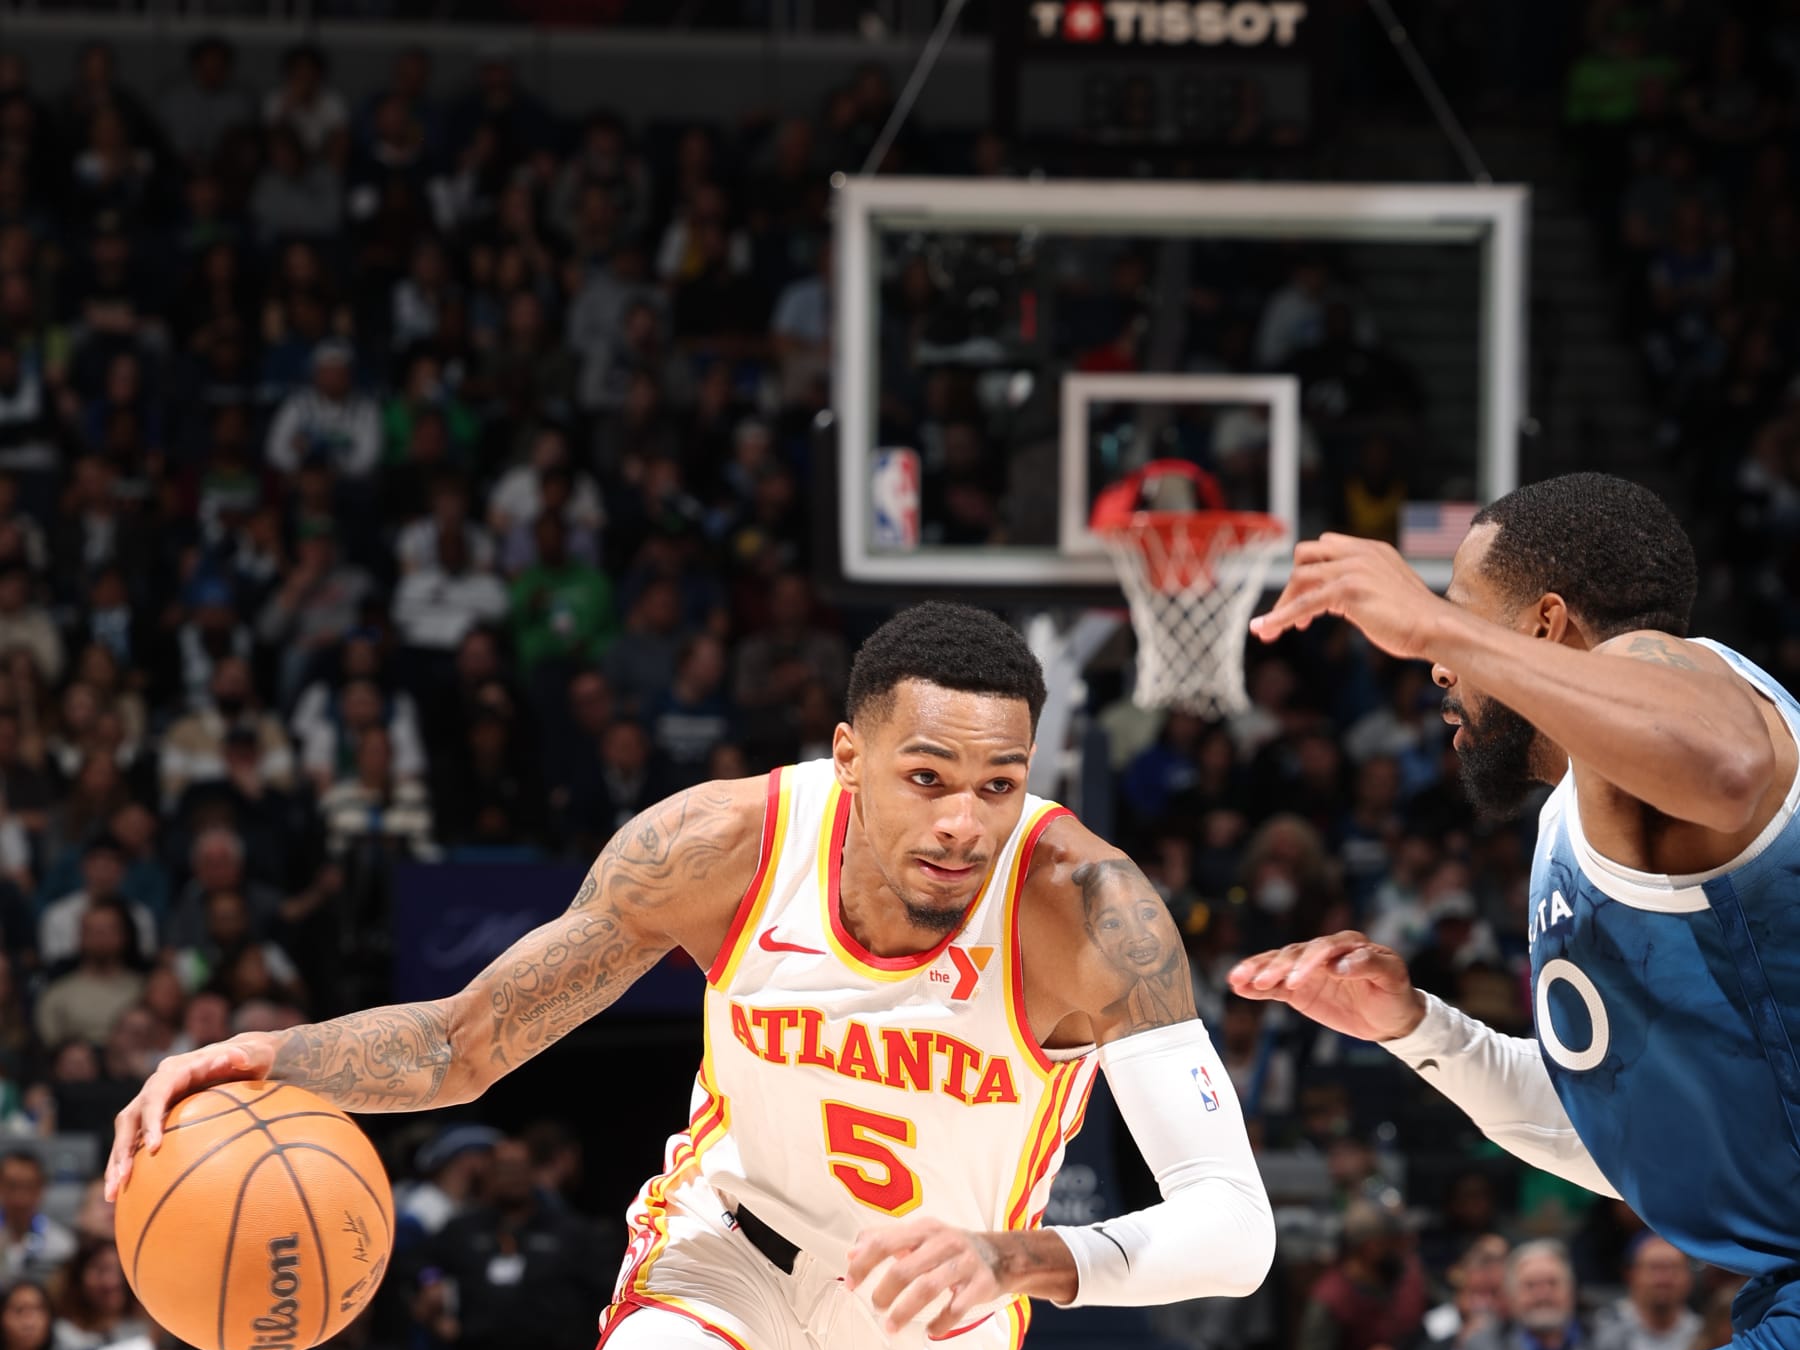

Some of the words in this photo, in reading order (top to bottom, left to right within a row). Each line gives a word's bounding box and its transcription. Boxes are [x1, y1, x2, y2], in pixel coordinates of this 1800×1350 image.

[1105, 1, 1307, 46] TISSOT
[929, 969, 951, 983] the
[518, 990, 570, 1025] Nothing
[729, 1000, 1021, 1107] ATLANTA
[820, 1097, 923, 1218] 5
